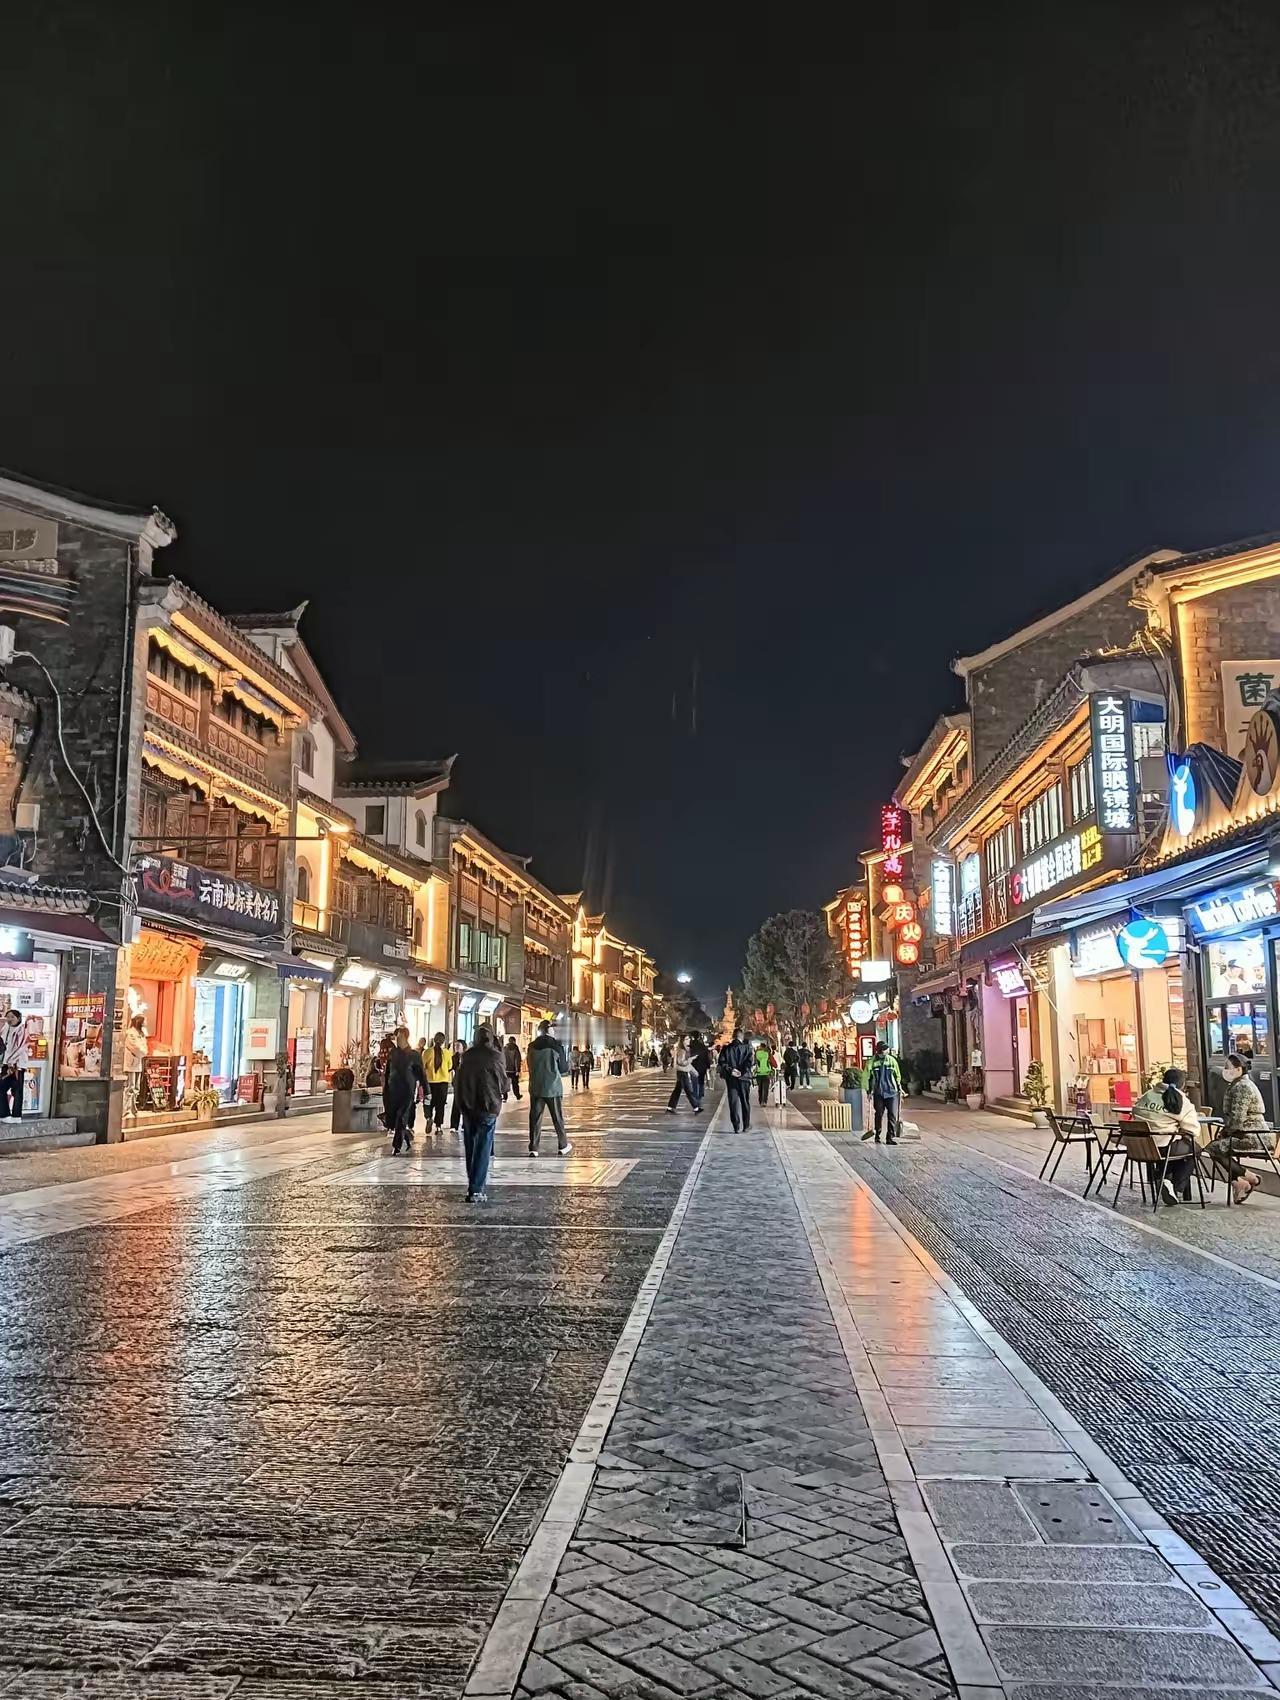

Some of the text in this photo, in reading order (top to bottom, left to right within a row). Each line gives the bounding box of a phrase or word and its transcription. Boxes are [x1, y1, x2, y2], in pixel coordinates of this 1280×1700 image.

[1098, 696, 1131, 829] 大明国际眼镜城
[884, 811, 903, 874] 芋儿鸡
[199, 878, 279, 924] 云南地标美食名片
[885, 887, 920, 963] 庆火锅
